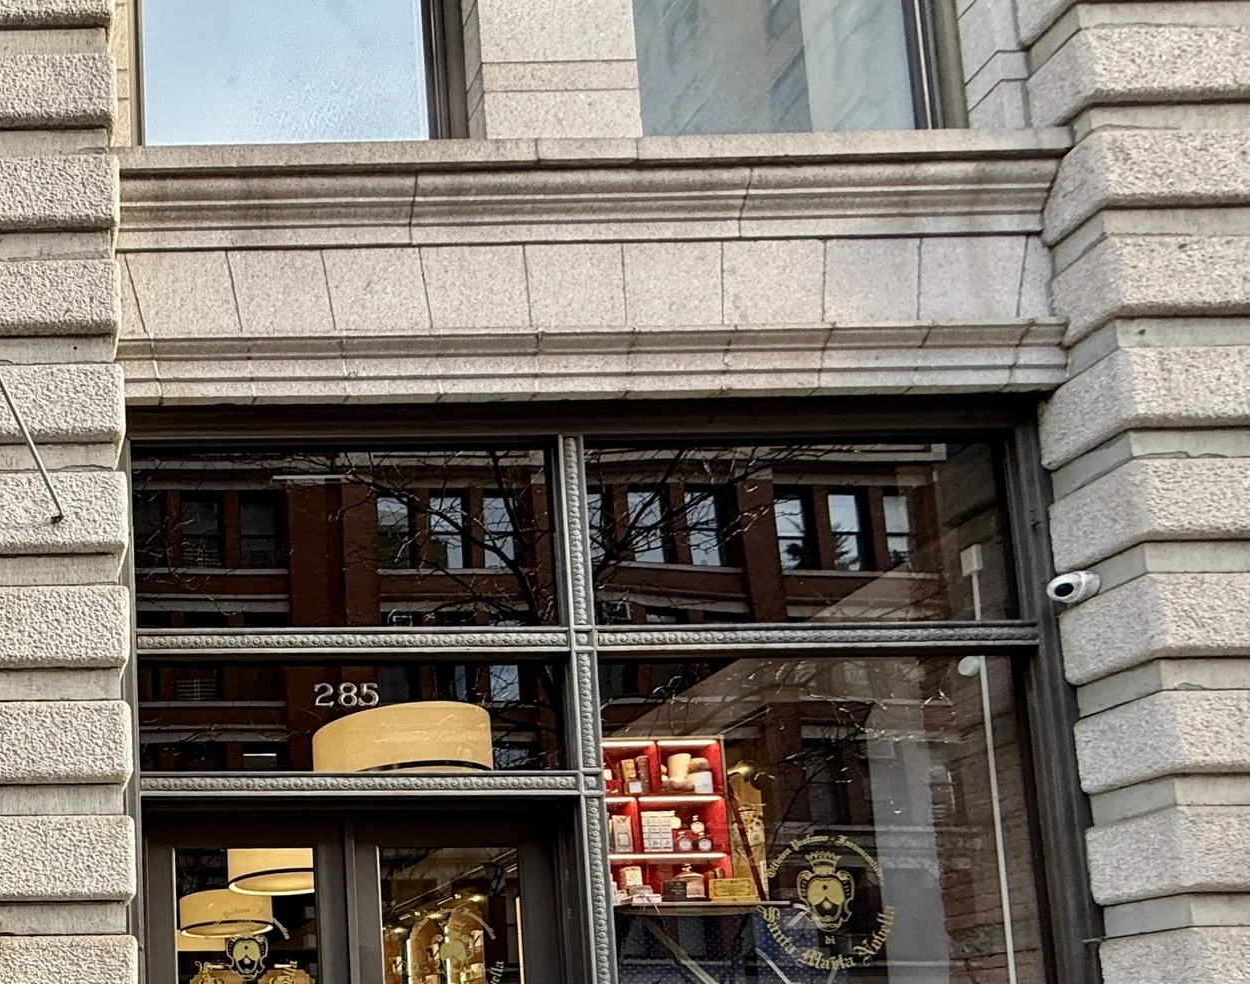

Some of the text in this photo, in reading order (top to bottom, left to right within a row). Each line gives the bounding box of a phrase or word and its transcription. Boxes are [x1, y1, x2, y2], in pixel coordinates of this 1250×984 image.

[314, 682, 379, 706] 285
[756, 905, 797, 955] Santa
[795, 947, 856, 970] Maria
[825, 935, 836, 945] di
